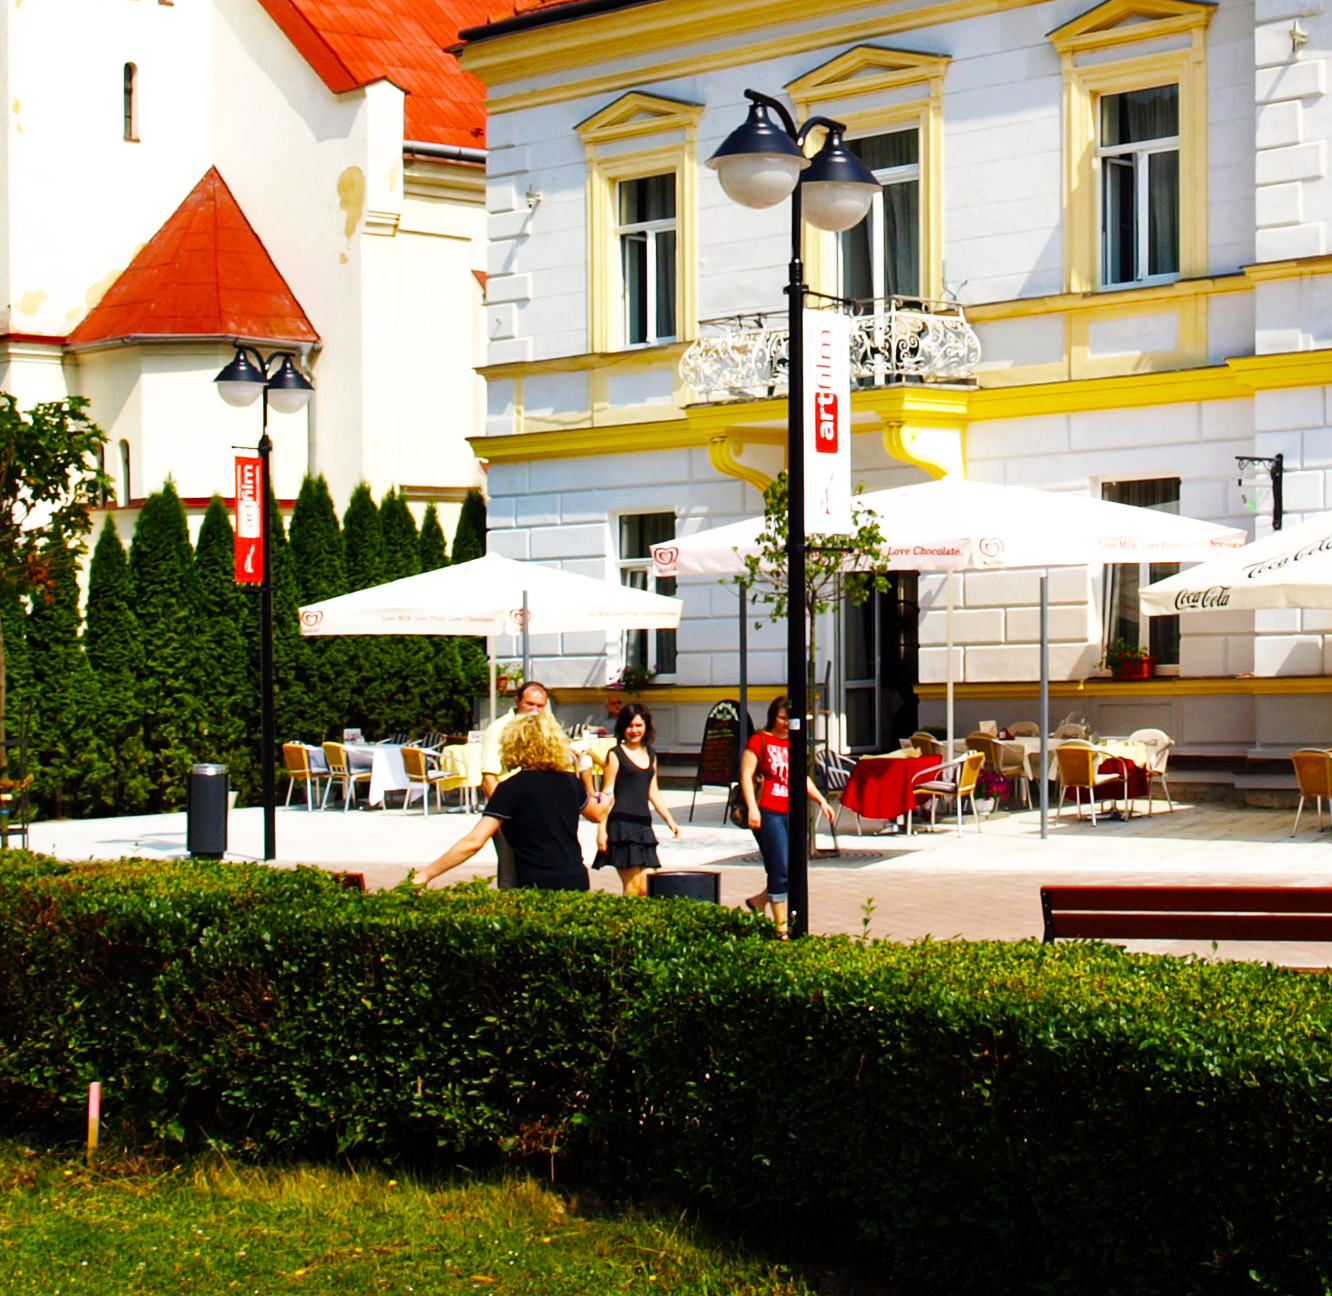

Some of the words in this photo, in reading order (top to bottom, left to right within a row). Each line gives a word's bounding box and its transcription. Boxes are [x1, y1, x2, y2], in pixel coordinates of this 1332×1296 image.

[816, 329, 834, 440] artfilm
[887, 546, 910, 556] Love
[913, 545, 964, 557] Chocolate.
